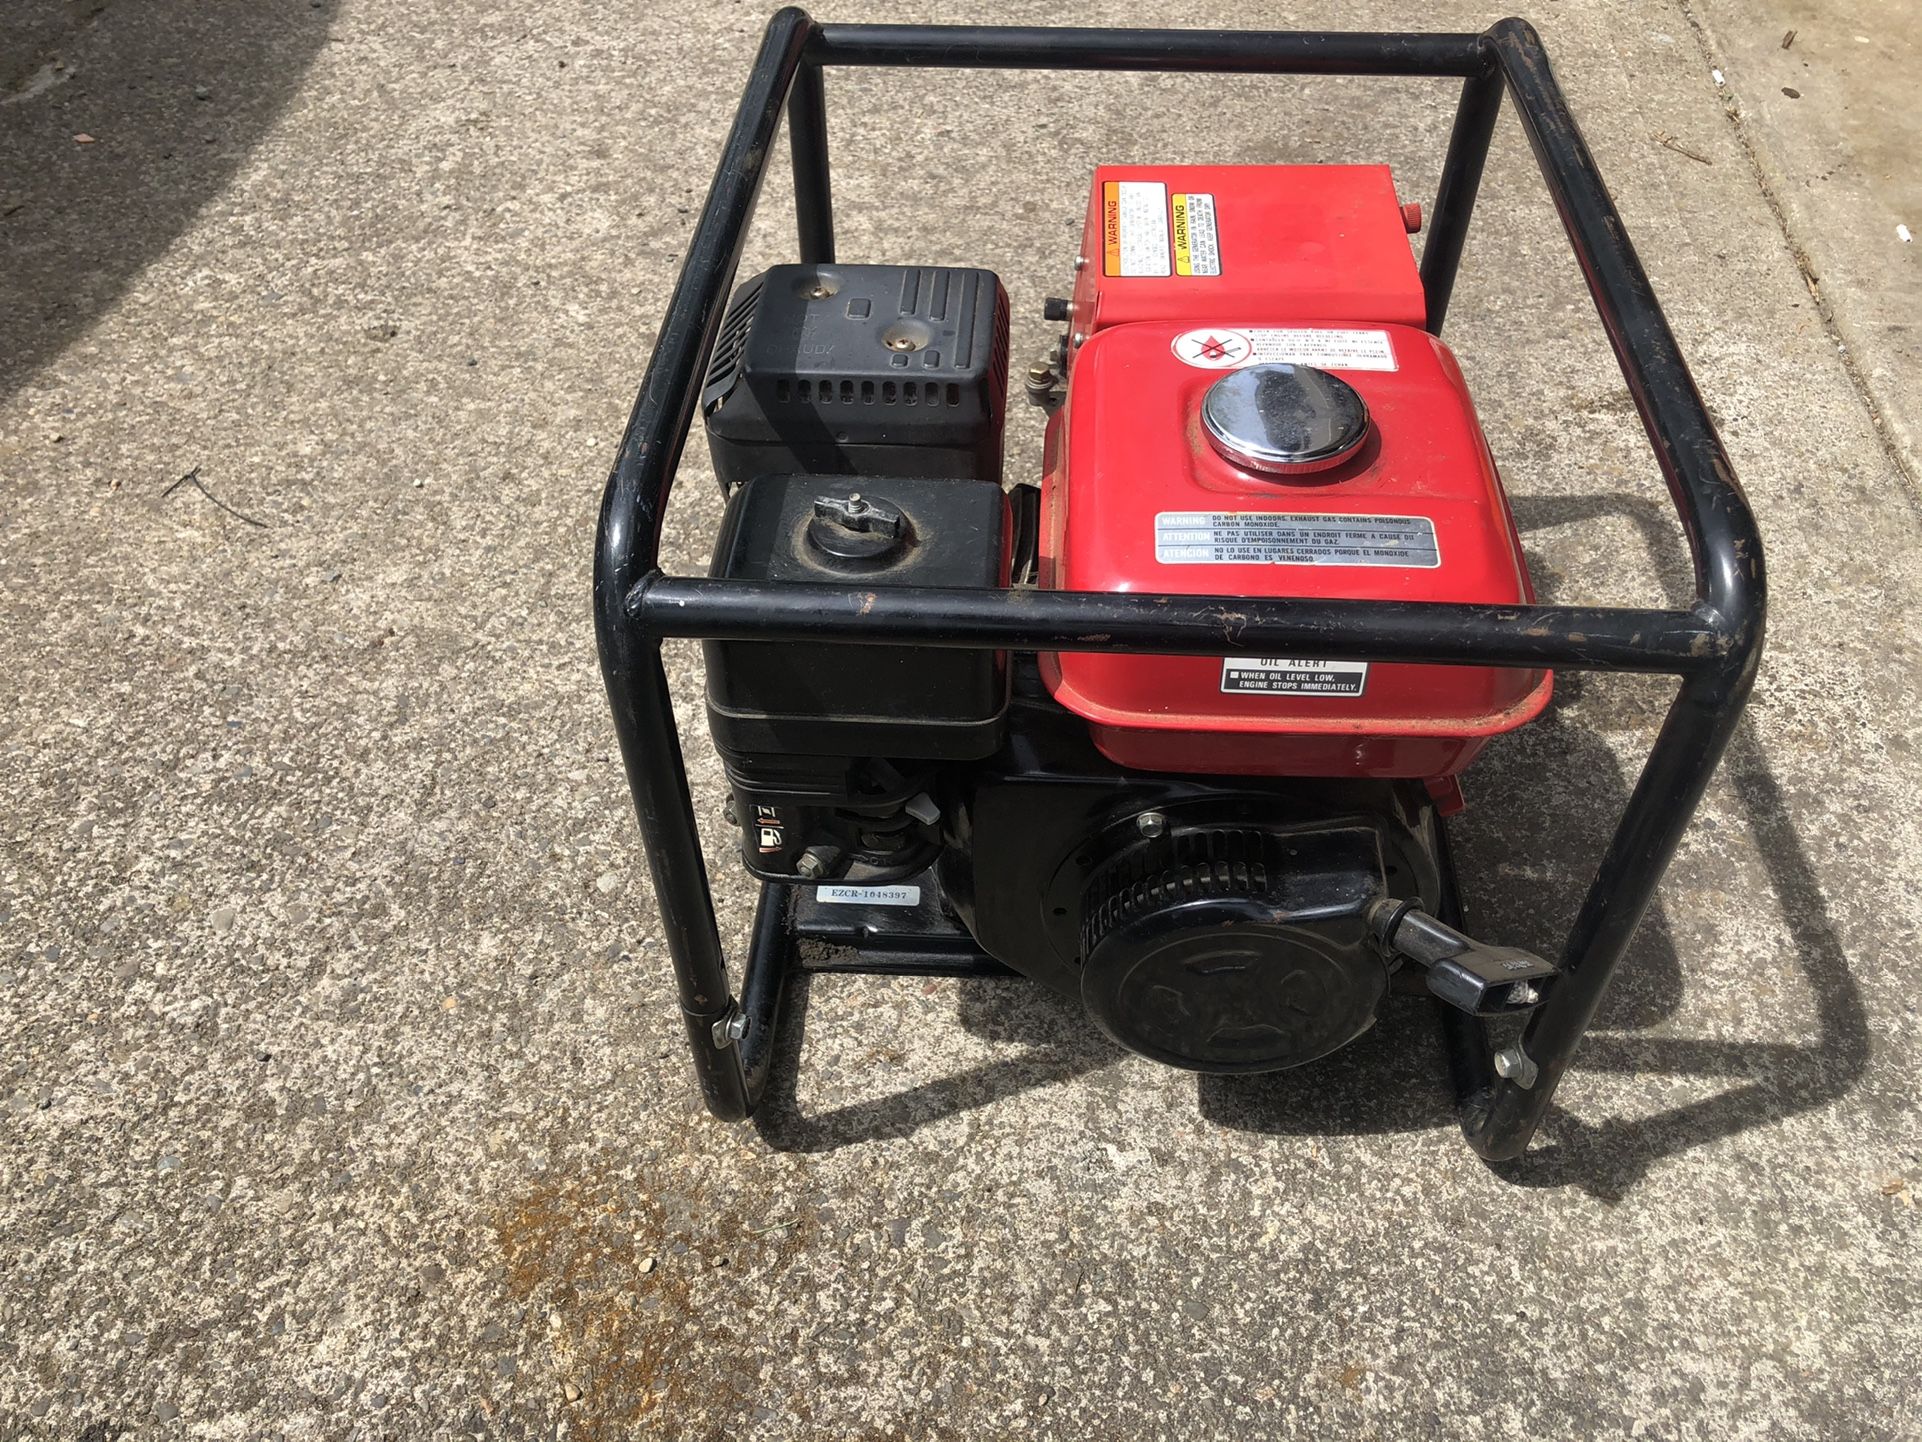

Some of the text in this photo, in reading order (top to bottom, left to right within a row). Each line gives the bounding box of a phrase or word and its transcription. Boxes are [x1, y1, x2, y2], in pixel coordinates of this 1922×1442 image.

[1107, 200, 1118, 246] WARNING
[1175, 204, 1188, 250] WARNING
[1161, 516, 1206, 526] WARNING
[1290, 515, 1320, 523] EXHAUST
[1339, 517, 1373, 525] CONTAINS
[1374, 518, 1412, 526] POISONOUS
[1162, 532, 1211, 543] ATTENTION
[1213, 530, 1223, 538] NE
[1226, 530, 1241, 538] PAS
[1276, 531, 1297, 539] DANS
[1299, 531, 1310, 539] UN
[1313, 532, 1342, 540] ENDROIT
[1379, 534, 1402, 542] CAUSE
[1214, 537, 1239, 545] RISQUE
[1241, 537, 1309, 545] D'EMPOISONNEMENT
[1311, 538, 1322, 546] DU
[1214, 547, 1225, 555] NO
[1226, 547, 1237, 555] LO
[1239, 547, 1253, 555] USE
[1254, 547, 1264, 555] EN
[1265, 547, 1295, 556] LUGARES
[1297, 548, 1333, 556] CERRADOS
[1335, 549, 1361, 557] PORQUE
[1374, 550, 1410, 559] MONOXIDE
[1215, 554, 1225, 562] DE
[1228, 554, 1261, 562] CARBONO
[1264, 554, 1275, 562] ES
[1260, 659, 1328, 669] OIL ALERT
[1240, 671, 1336, 682] WHEN OIL LEVEL LOW,
[1238, 680, 1358, 692] ENGINE STOPS IMMEDIATELY.
[831, 889, 908, 900] EZCR-1048397
